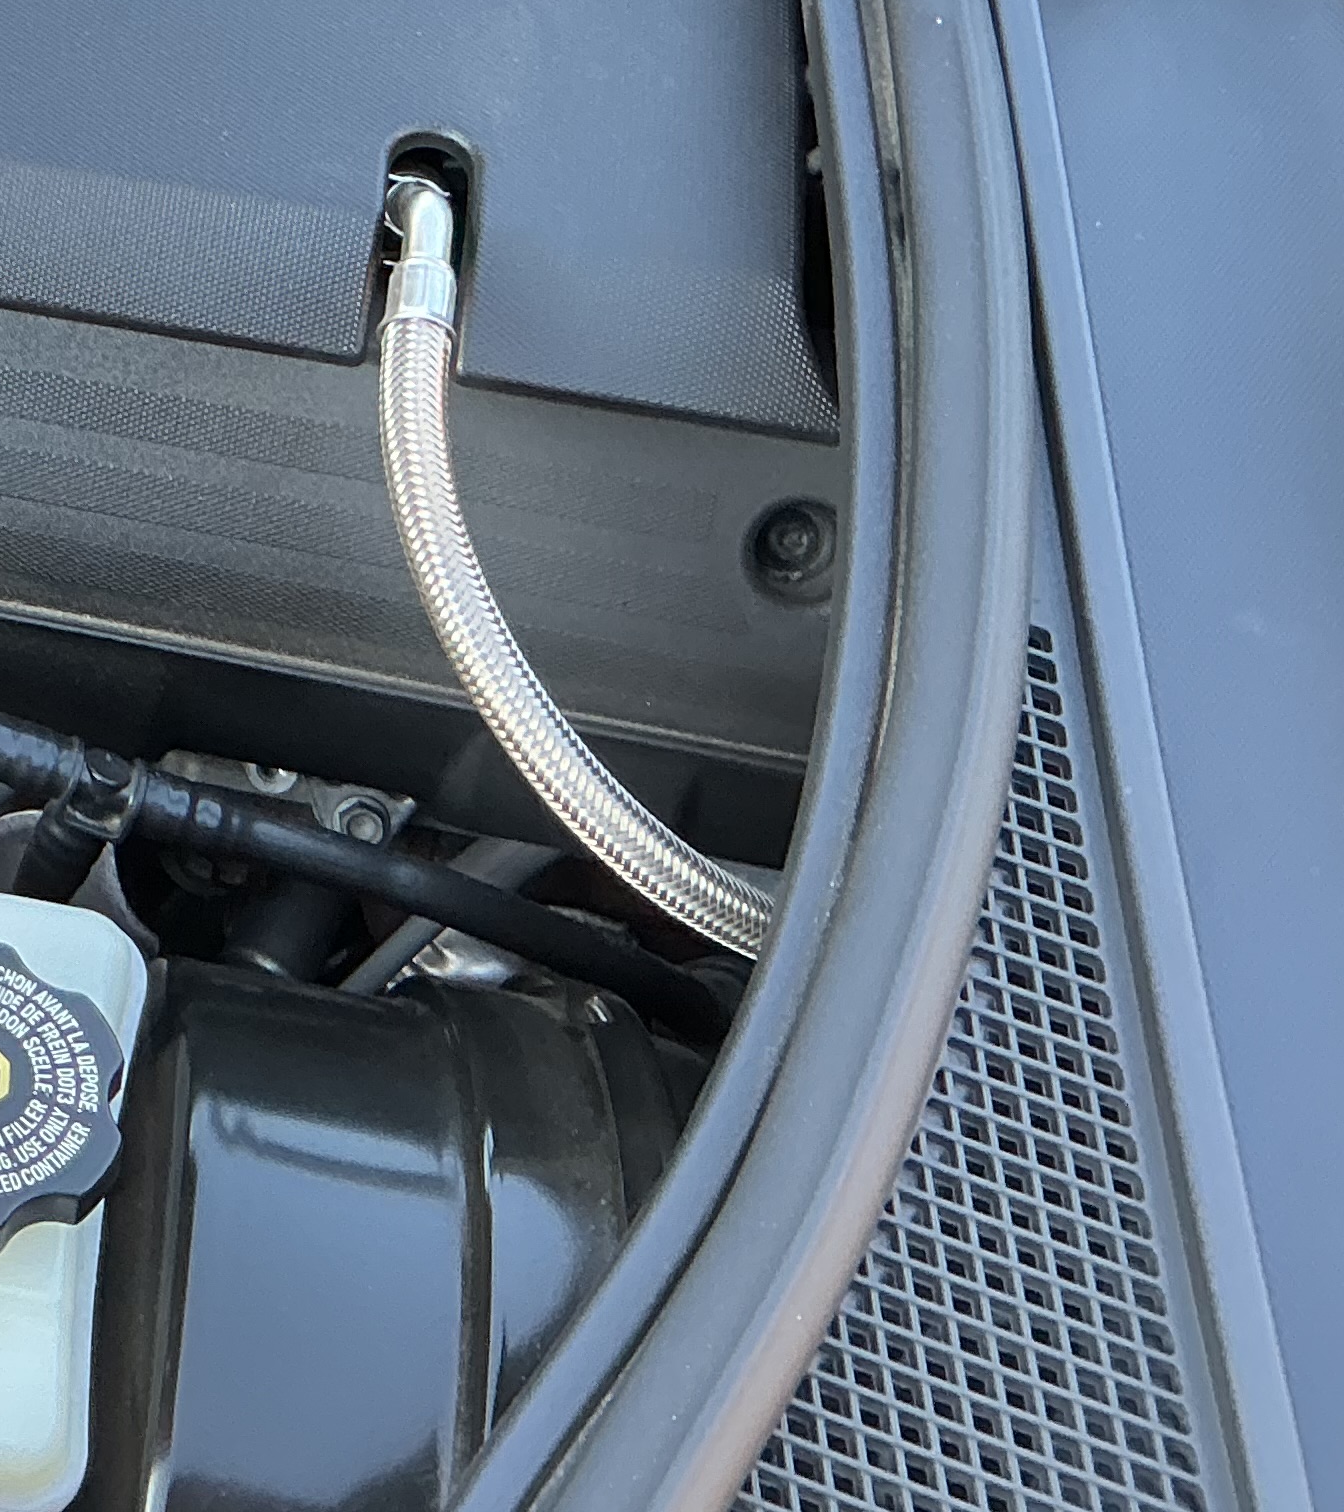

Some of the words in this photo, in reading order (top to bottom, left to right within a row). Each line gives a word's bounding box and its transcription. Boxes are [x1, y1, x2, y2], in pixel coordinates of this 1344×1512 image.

[32, 990, 79, 1033] AVANT
[20, 1002, 45, 1026] DE
[37, 1021, 72, 1065] FREIN
[56, 1067, 76, 1105] DOT3
[67, 1031, 89, 1054] LA
[76, 1055, 99, 1113] DEPOSE.
[2, 1099, 48, 1144] FILLER
[13, 1136, 47, 1163] USE
[39, 1106, 70, 1144] ONLY
